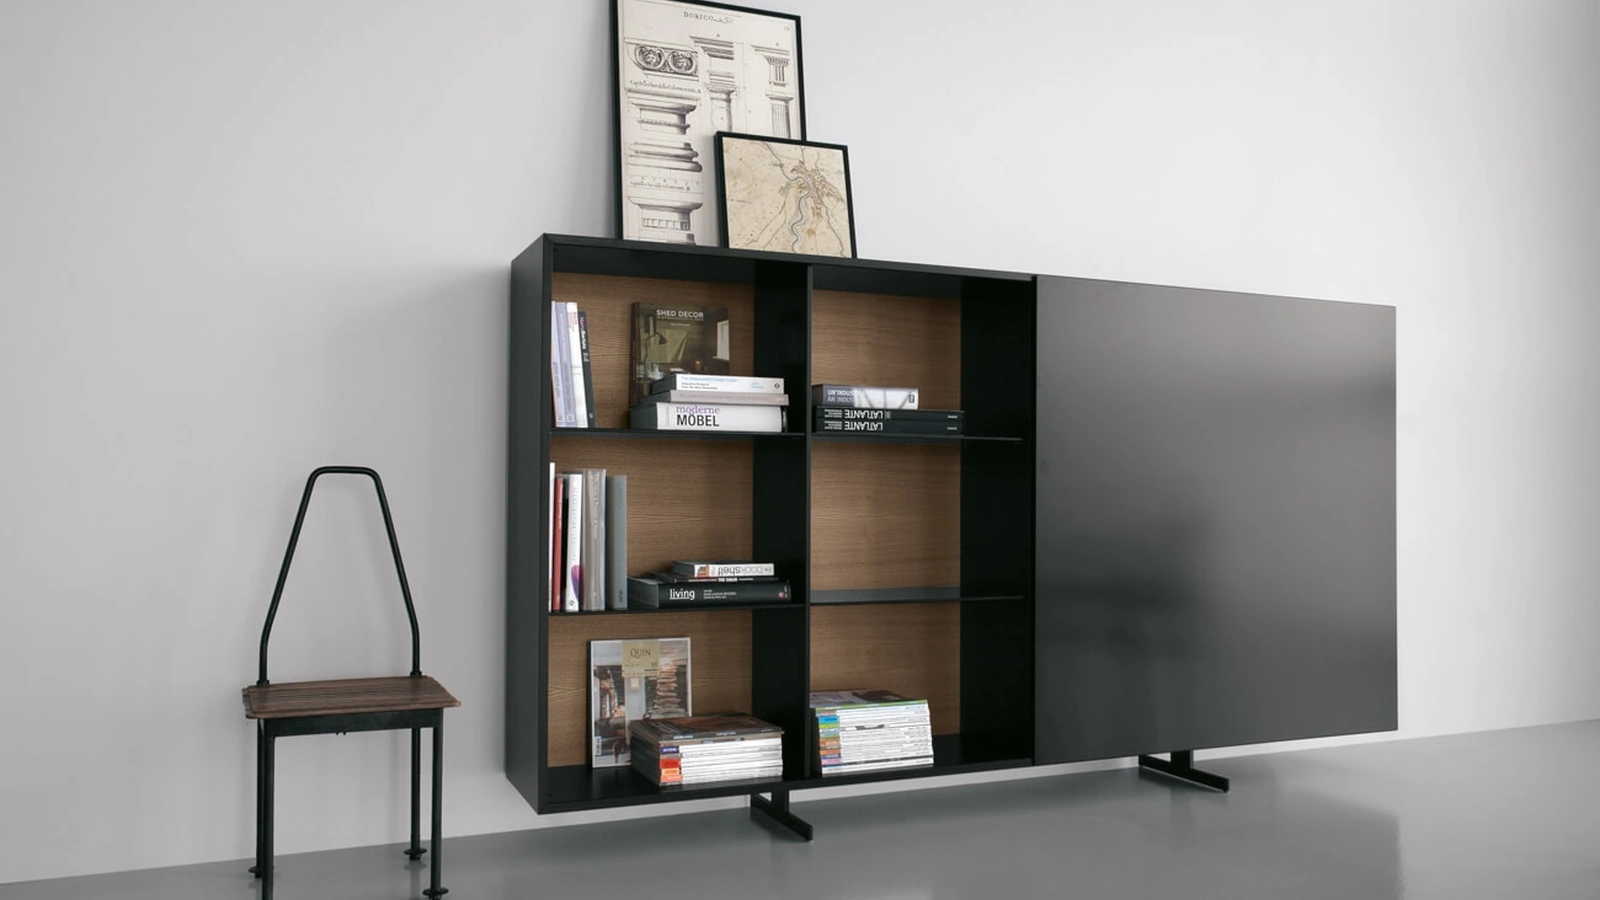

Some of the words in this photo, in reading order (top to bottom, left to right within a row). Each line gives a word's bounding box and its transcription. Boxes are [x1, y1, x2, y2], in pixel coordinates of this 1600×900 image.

[683, 11, 714, 21] DORICO
[656, 309, 677, 317] SHED
[678, 311, 704, 319] DECOR
[676, 405, 720, 415] moderne
[676, 413, 720, 427] MÖBEL
[669, 588, 696, 601] living
